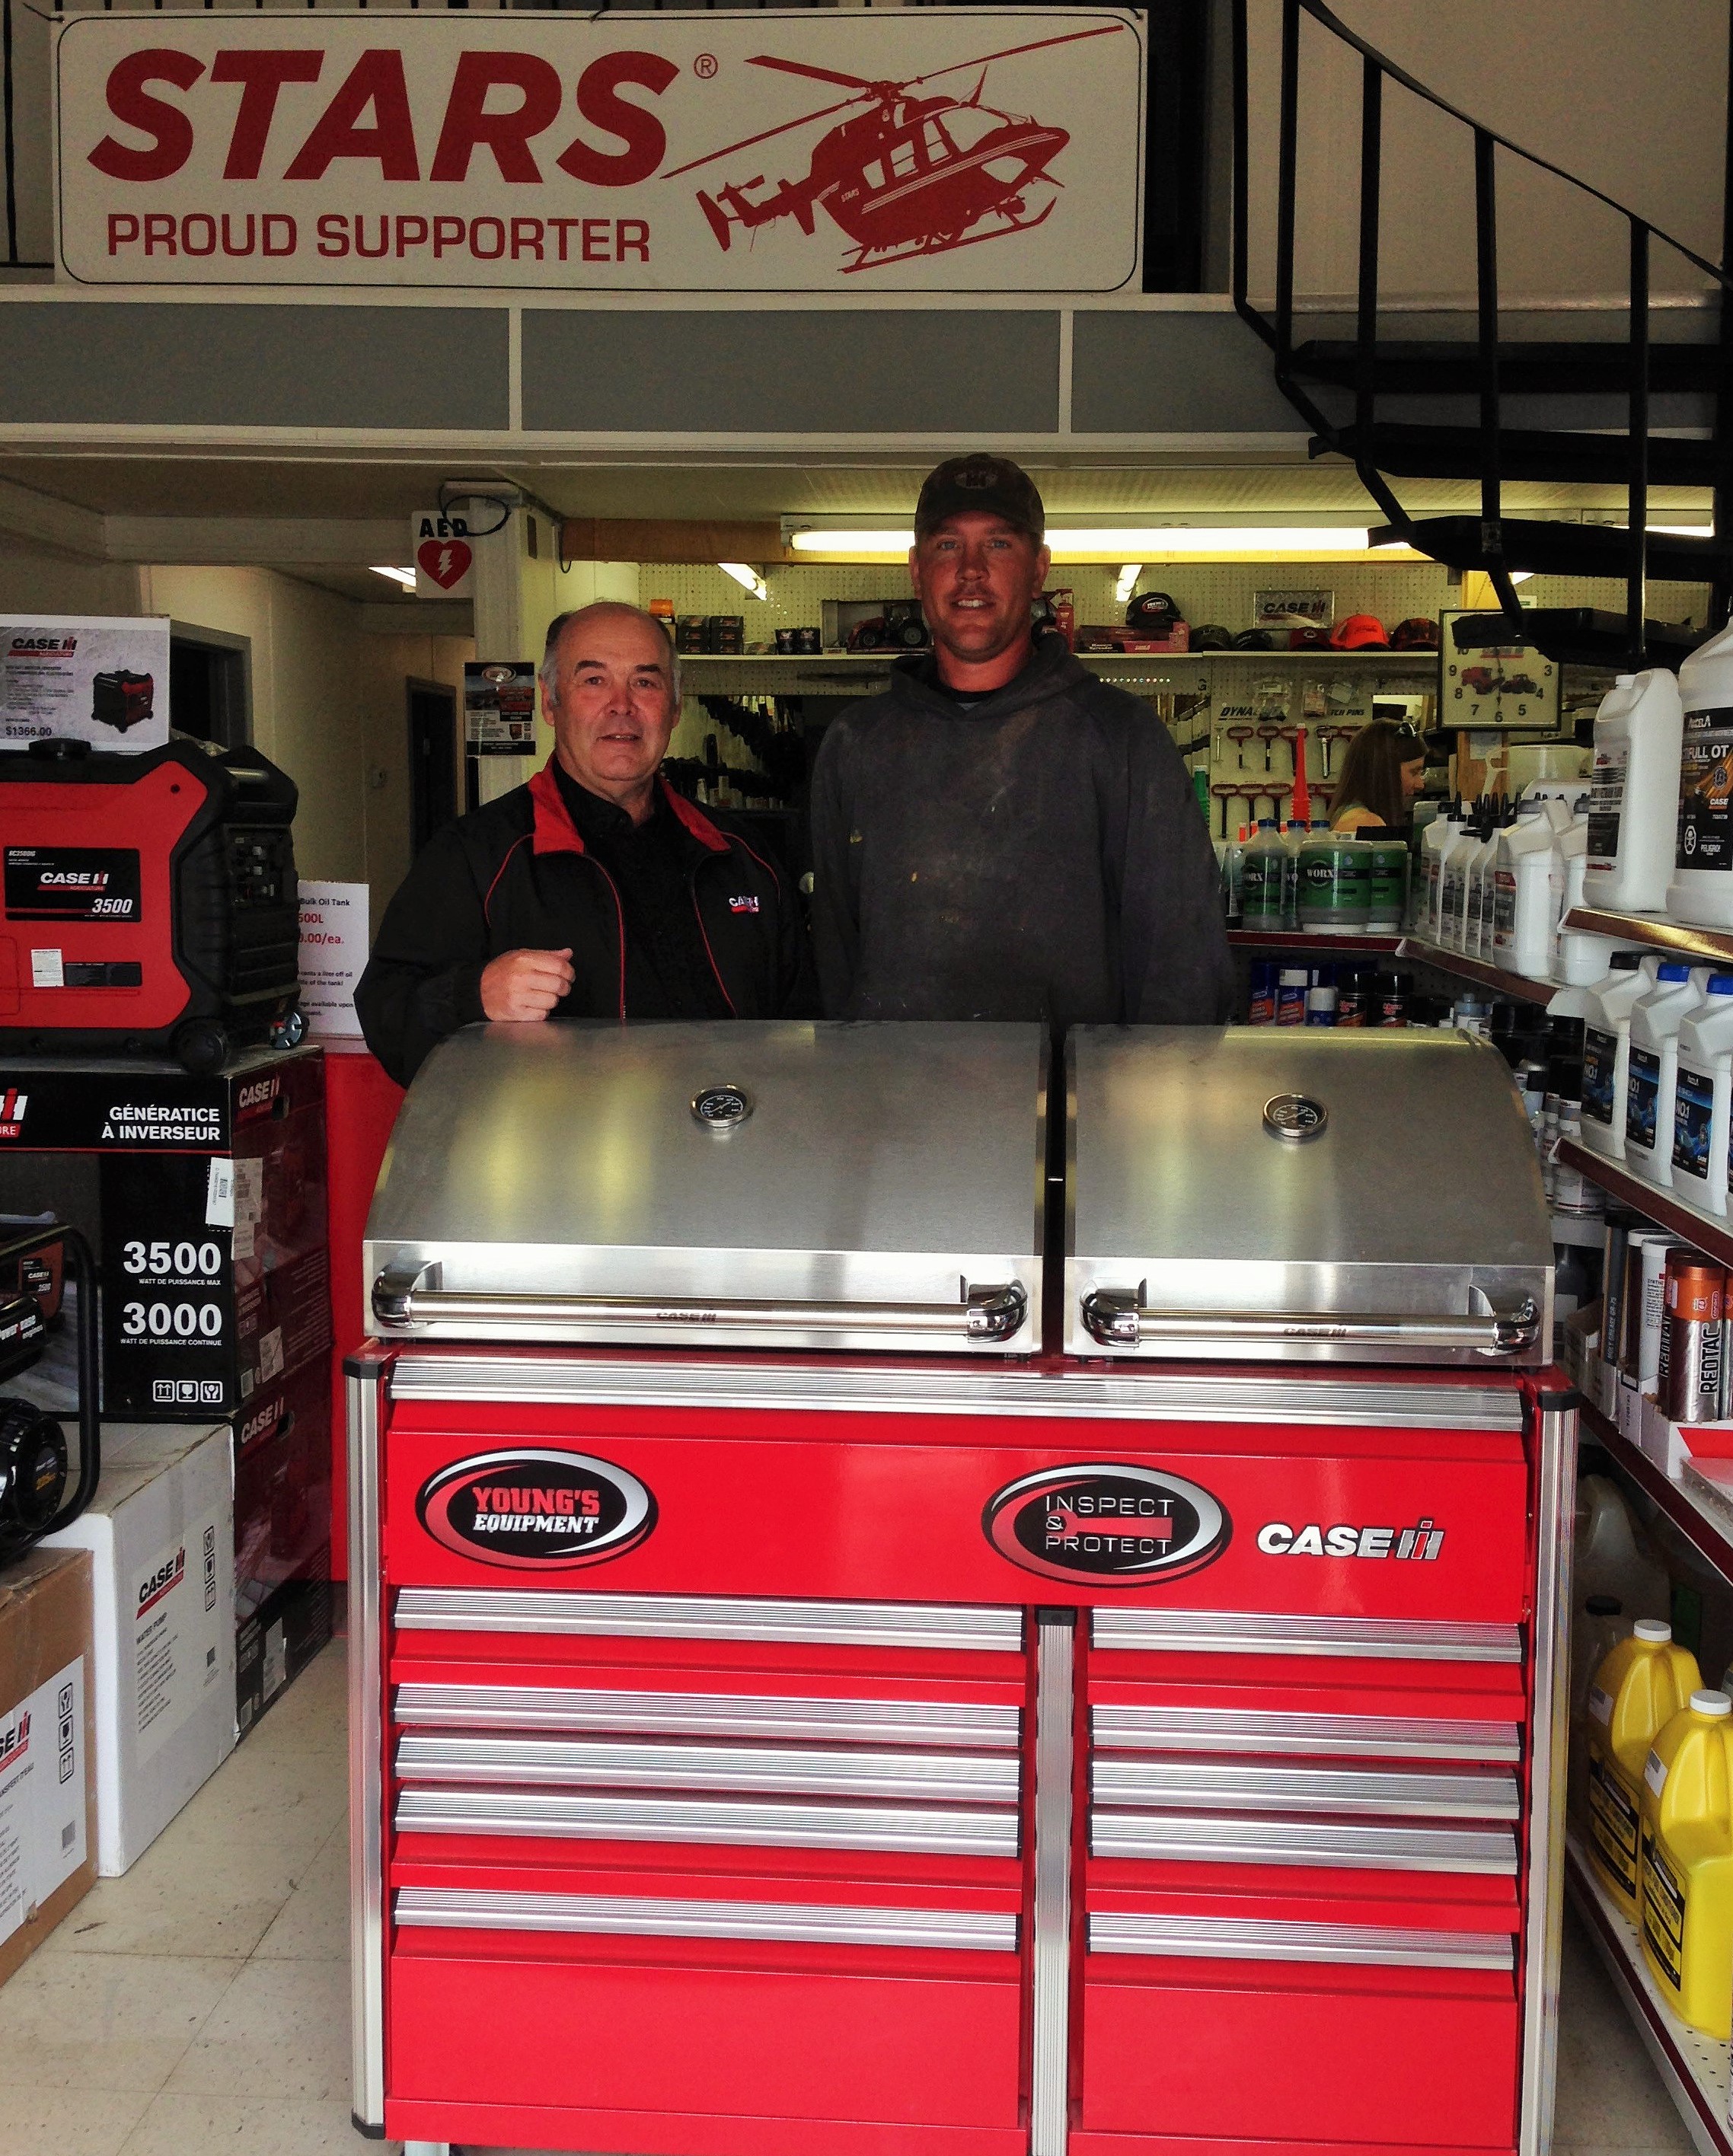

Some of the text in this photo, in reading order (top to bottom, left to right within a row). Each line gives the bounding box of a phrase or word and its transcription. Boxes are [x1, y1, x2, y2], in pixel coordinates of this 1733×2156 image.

[87, 49, 680, 187] STARS
[107, 213, 650, 262] PROUD SUPPORTER
[420, 518, 468, 537] AED
[1264, 602, 1310, 614] CASE
[11, 637, 60, 649] CASE
[1448, 665, 1457, 676] 9
[1544, 665, 1553, 676] 3
[1454, 687, 1463, 699] 8
[1535, 687, 1543, 700] 4
[1471, 704, 1479, 716] 7
[1518, 704, 1527, 716] 5
[5, 726, 53, 736] $1366.00
[40, 872, 91, 884] CASE
[92, 898, 133, 914] 3500
[331, 898, 350, 907] Tank
[239, 1079, 271, 1108] CASE
[109, 1104, 220, 1121] GÉNÉRATICE
[101, 1122, 220, 1140] À INVERSEUR
[123, 1242, 222, 1275] 3500
[123, 1302, 222, 1336] 3000
[1699, 1322, 1721, 1395] REDTAC
[241, 1405, 273, 1444] CASE
[472, 1486, 600, 1516] YOUNG'S
[1045, 1494, 1175, 1517] INSPECT
[473, 1513, 599, 1533] EQUIPMENT
[1045, 1516, 1063, 1531] &
[1045, 1536, 1173, 1555] PROTECT
[1256, 1523, 1393, 1558] CASE
[139, 1559, 174, 1603] CASE
